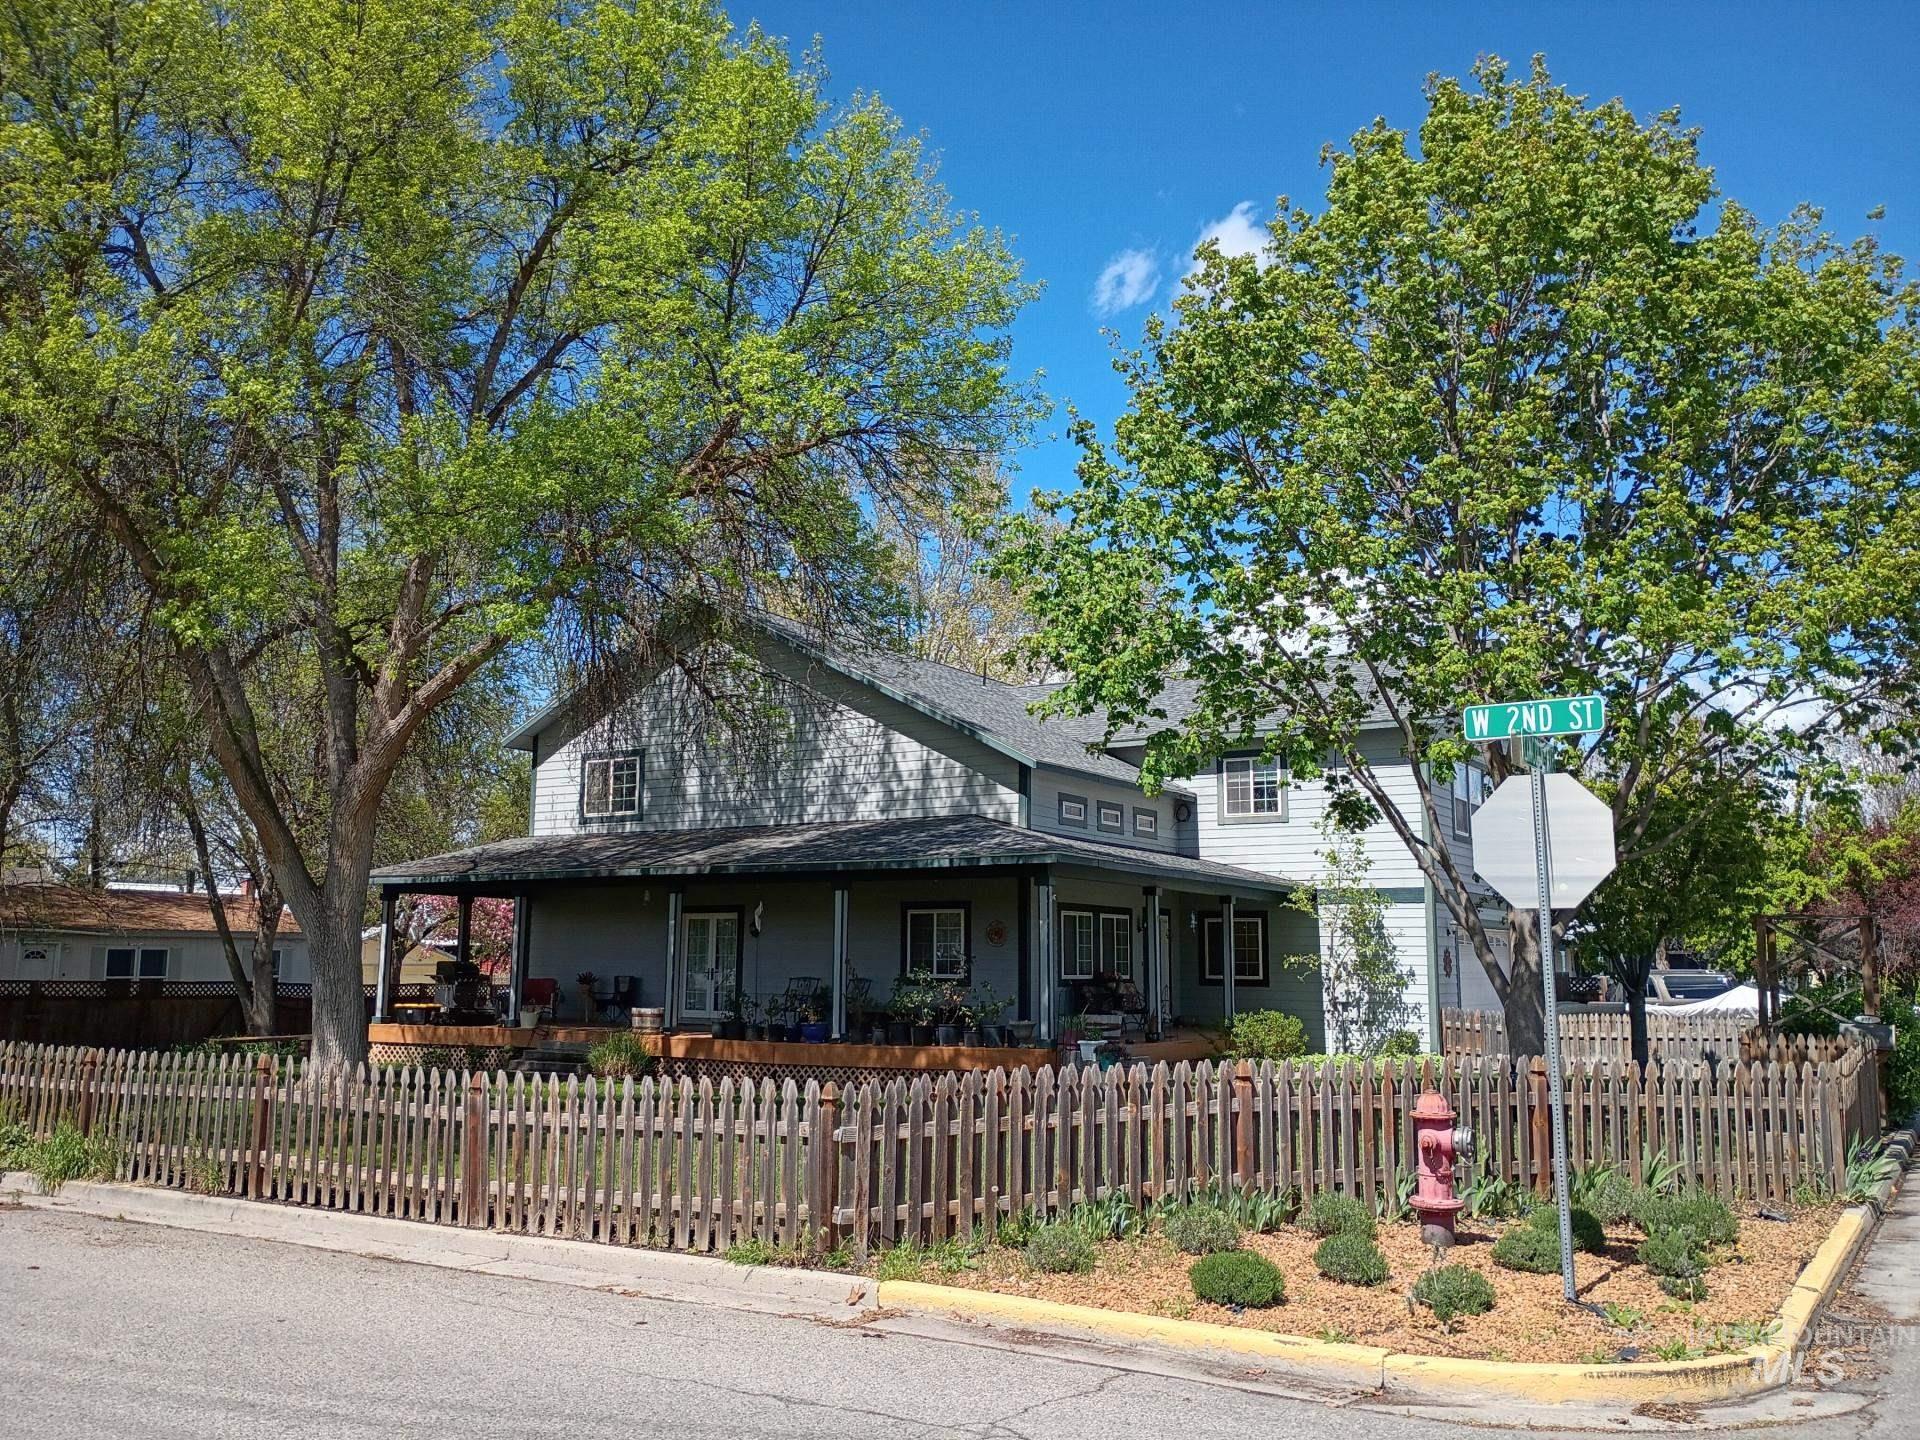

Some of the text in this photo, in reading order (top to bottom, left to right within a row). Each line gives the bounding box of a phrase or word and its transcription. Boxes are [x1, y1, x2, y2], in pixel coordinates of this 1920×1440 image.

[1471, 700, 1594, 737] W 2ND ST
